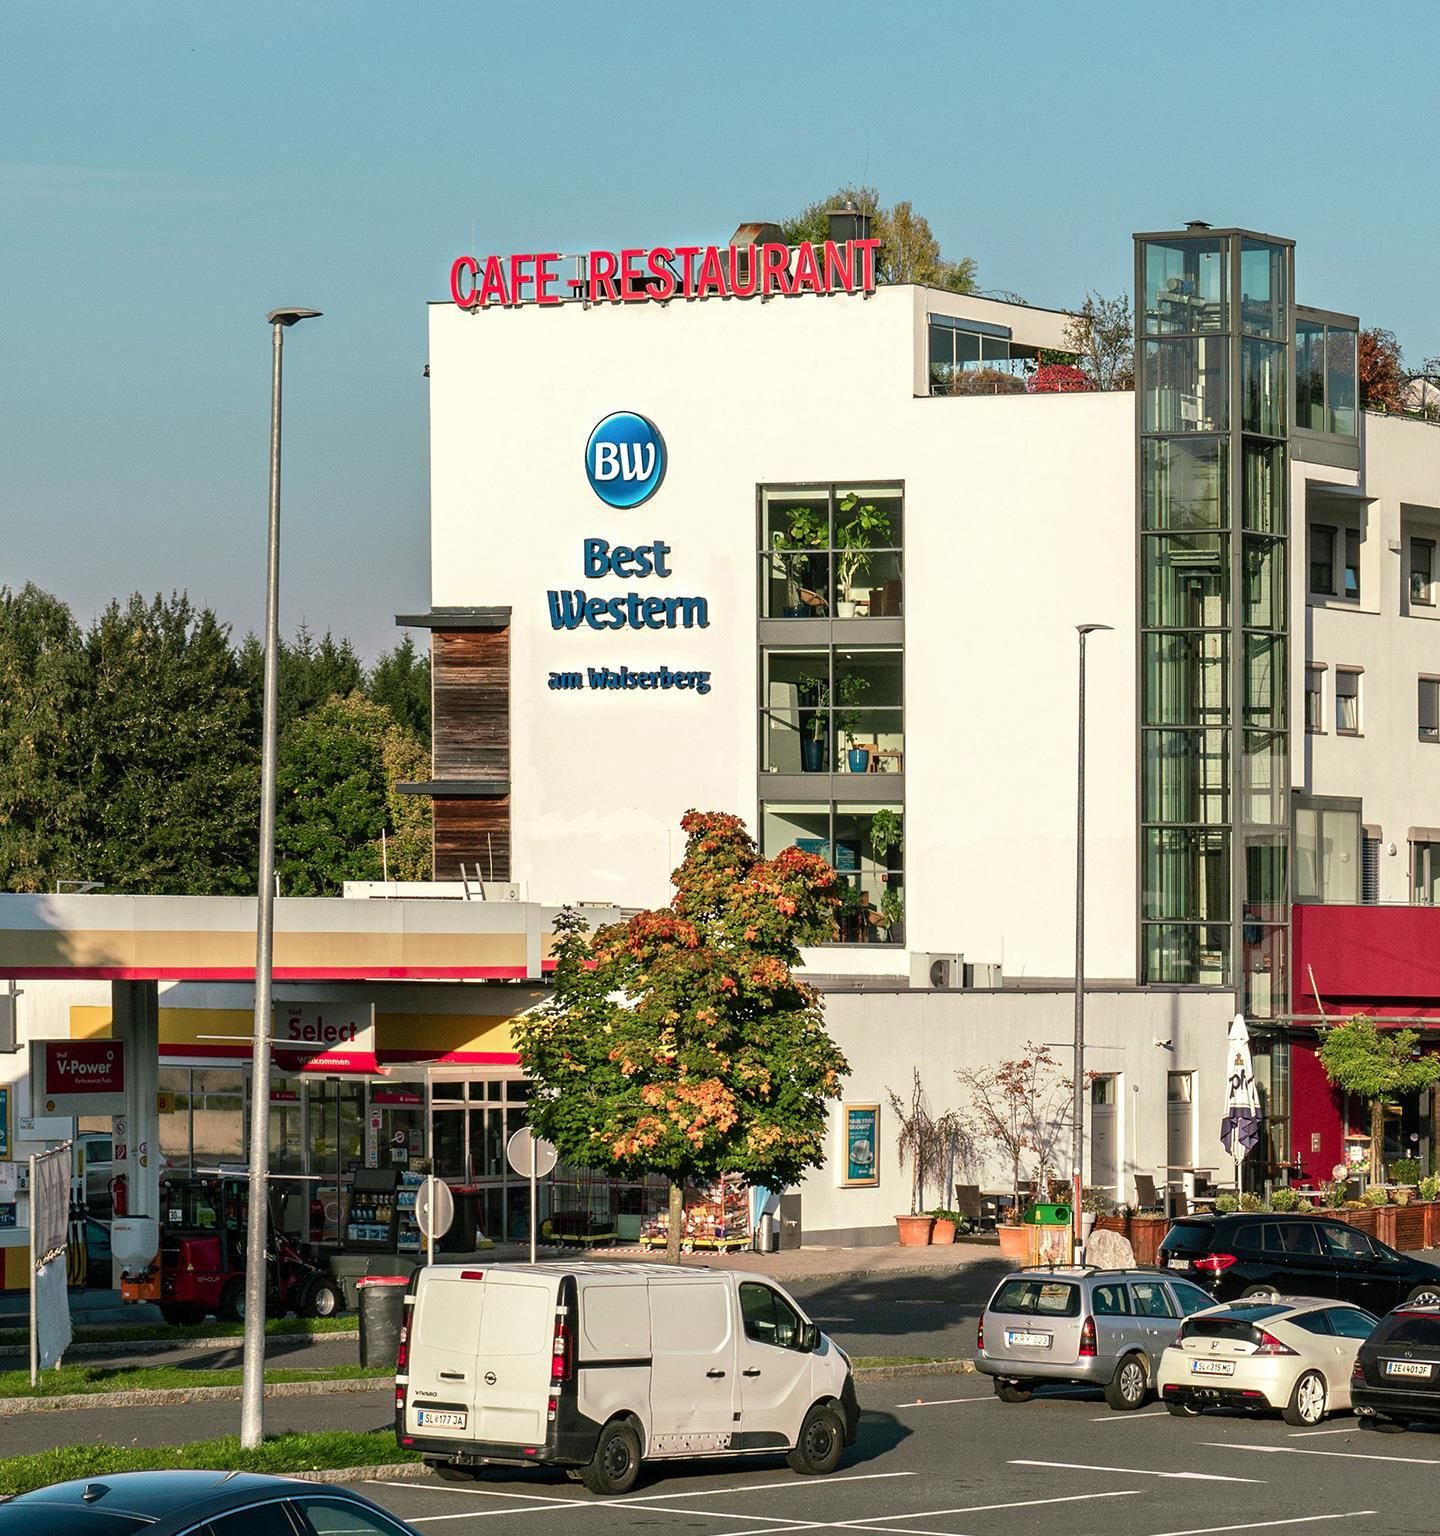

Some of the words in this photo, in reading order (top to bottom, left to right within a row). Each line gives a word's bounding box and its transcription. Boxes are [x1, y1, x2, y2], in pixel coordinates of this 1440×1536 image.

[450, 253, 563, 309] CAFE
[589, 238, 882, 302] RESTAURANT
[594, 442, 656, 482] BW
[584, 538, 672, 579] Best
[547, 590, 710, 631] Western
[548, 671, 583, 691] am
[587, 666, 712, 695] Walserberg
[288, 1016, 358, 1042] Select
[57, 1060, 112, 1075] V-Power
[297, 1056, 350, 1066] Willkommen
[1393, 1364, 1402, 1373] ZE
[425, 1413, 434, 1424] SL
[439, 1415, 452, 1425] 177
